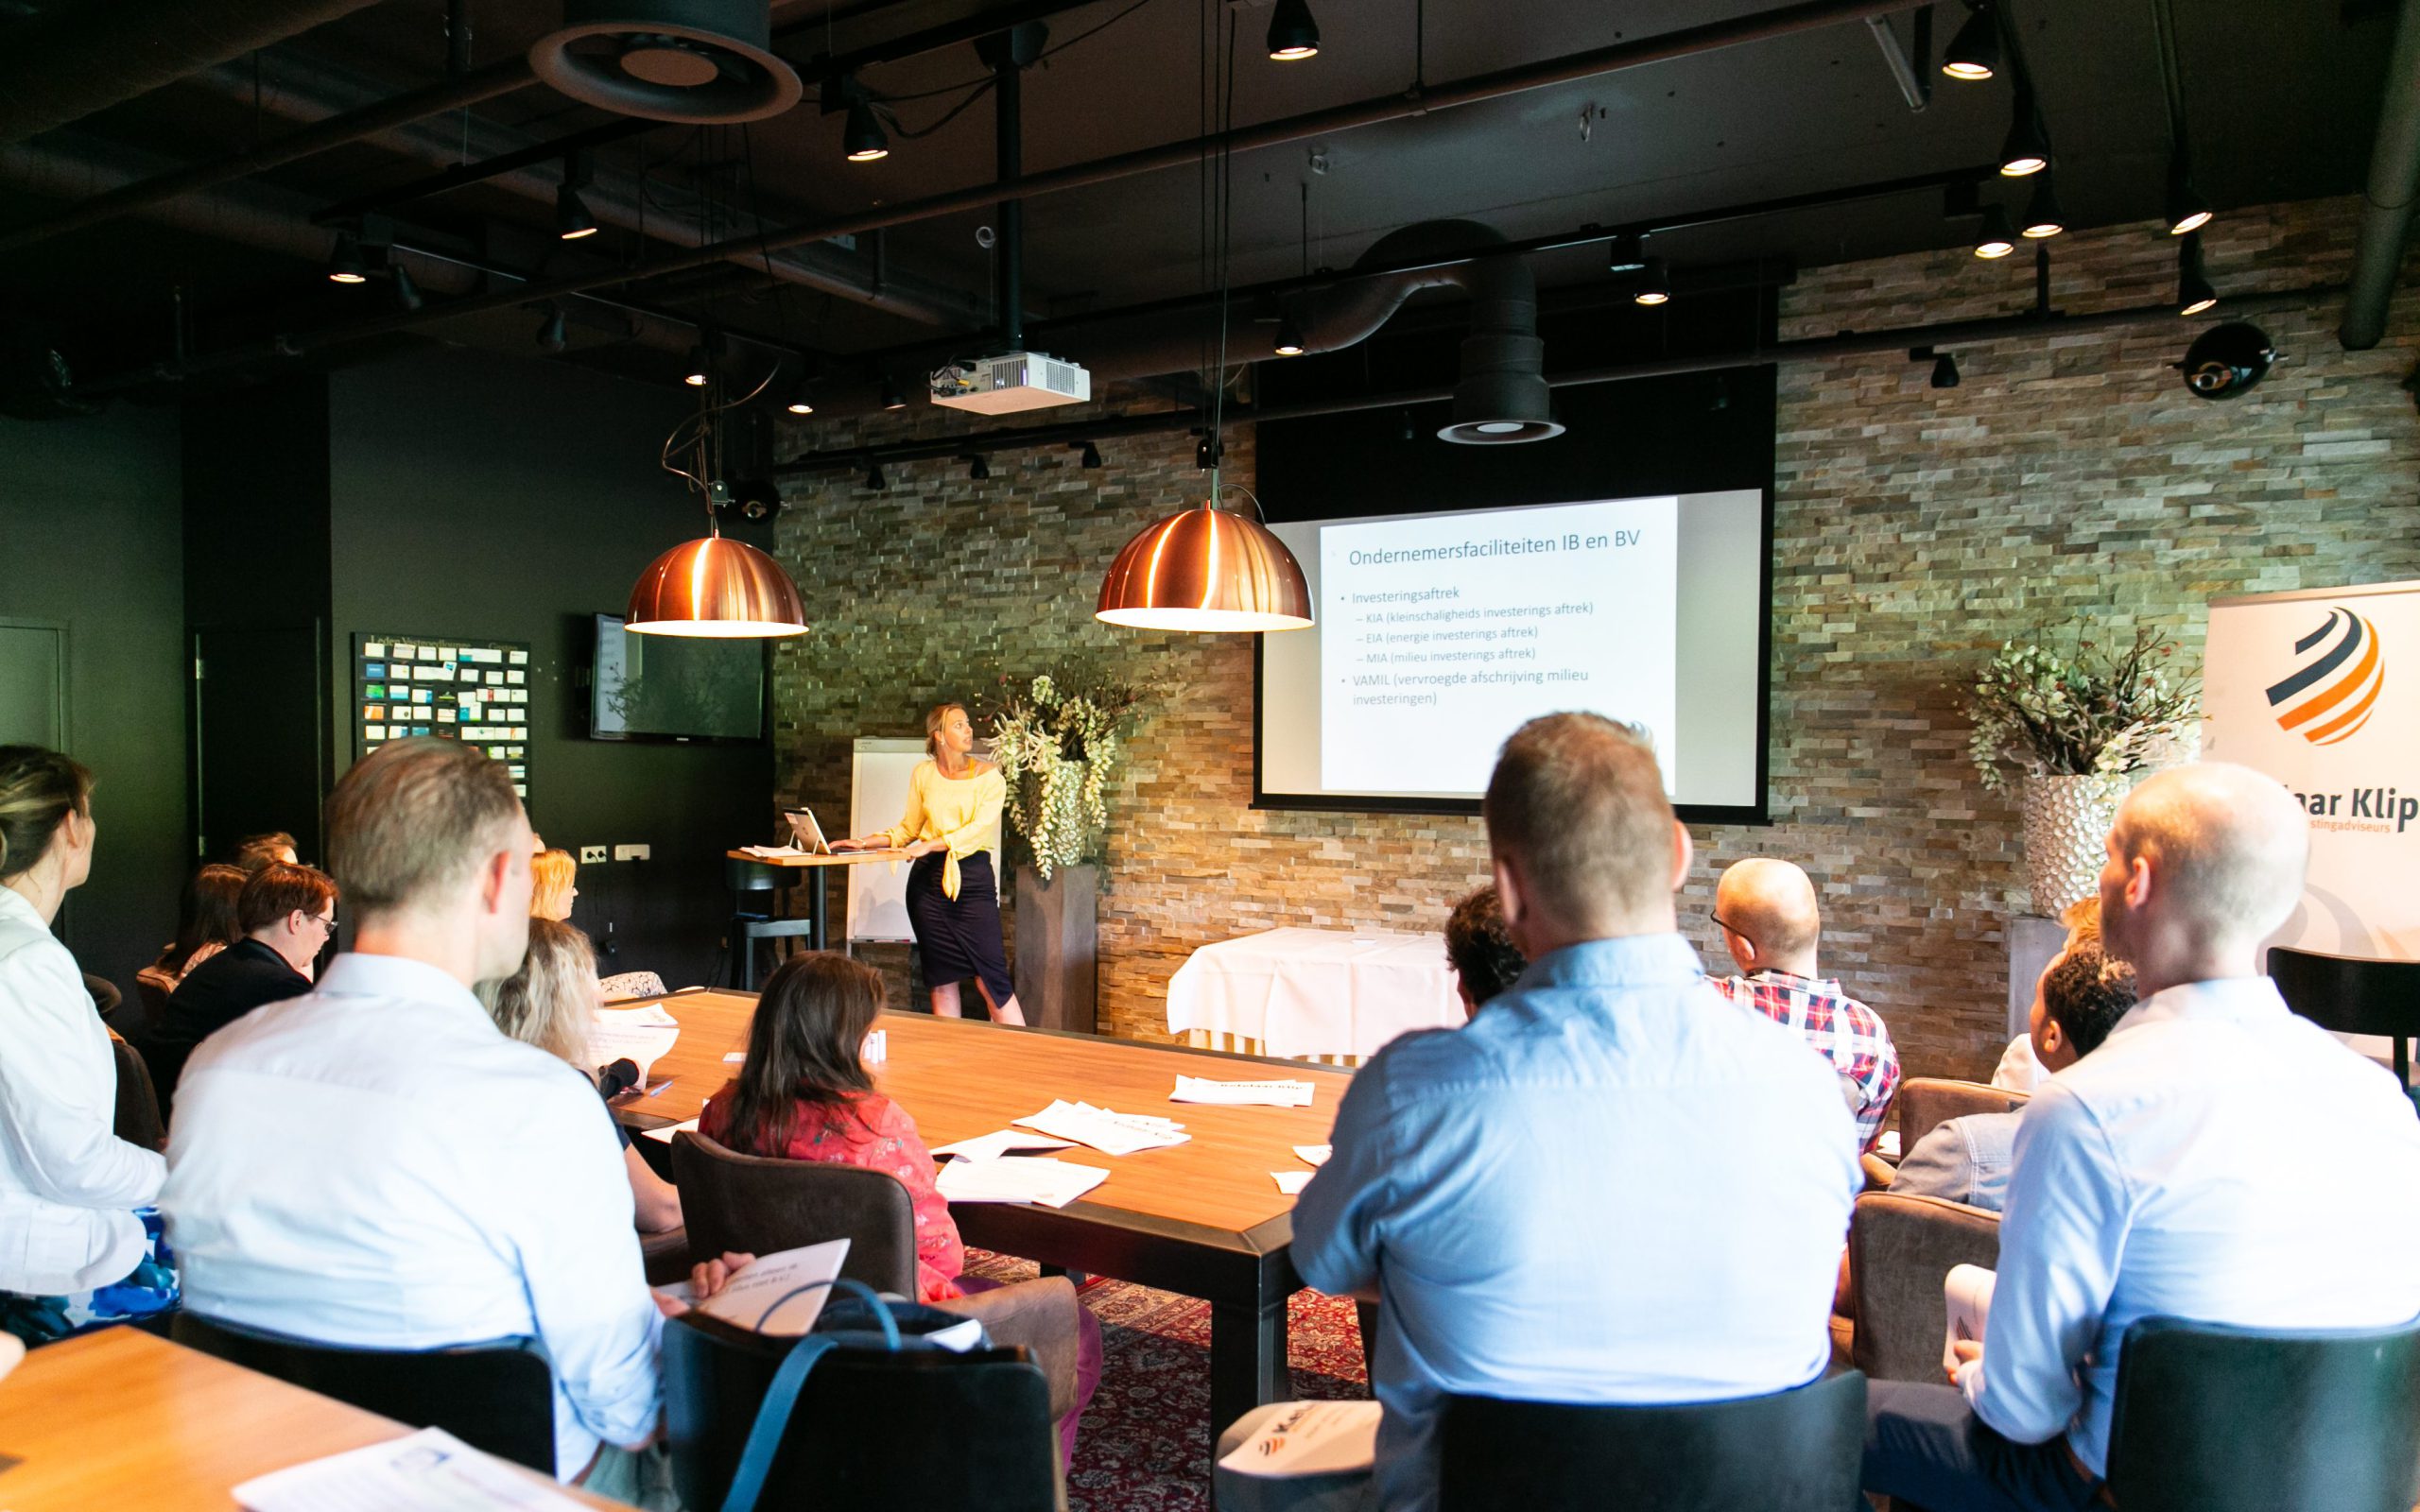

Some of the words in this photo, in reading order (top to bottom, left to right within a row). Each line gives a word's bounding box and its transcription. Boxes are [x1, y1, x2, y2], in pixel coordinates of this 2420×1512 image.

[1349, 537, 1556, 566] Ondernemersfaciliteiten
[1563, 534, 1580, 551] IB
[1585, 535, 1608, 549] en
[1615, 529, 1641, 547] BV
[1352, 586, 1460, 604] Investeringsaftrek
[1366, 612, 1384, 624] KIA
[1386, 608, 1481, 625] (kleinschaligheids
[1483, 605, 1552, 618] investerings
[1554, 602, 1594, 616] aftrek)
[1366, 633, 1383, 644] EIA
[1386, 631, 1430, 644] (energie
[1432, 628, 1497, 642] investerings
[1500, 626, 1538, 639] aftrek)
[1366, 652, 1388, 663] MIA
[1391, 651, 1427, 664] (milieu
[1430, 649, 1495, 662] investerings
[1498, 646, 1536, 660] aftrek)
[1353, 674, 1391, 686] VAMIL
[1393, 672, 1467, 688] (vervroegde
[1470, 670, 1544, 686] afschrijving
[1547, 668, 1589, 681] milieu
[1353, 692, 1438, 707] investeringen)
[2351, 786, 2419, 833] Klip
[2309, 817, 2391, 833] stingadviseurs
